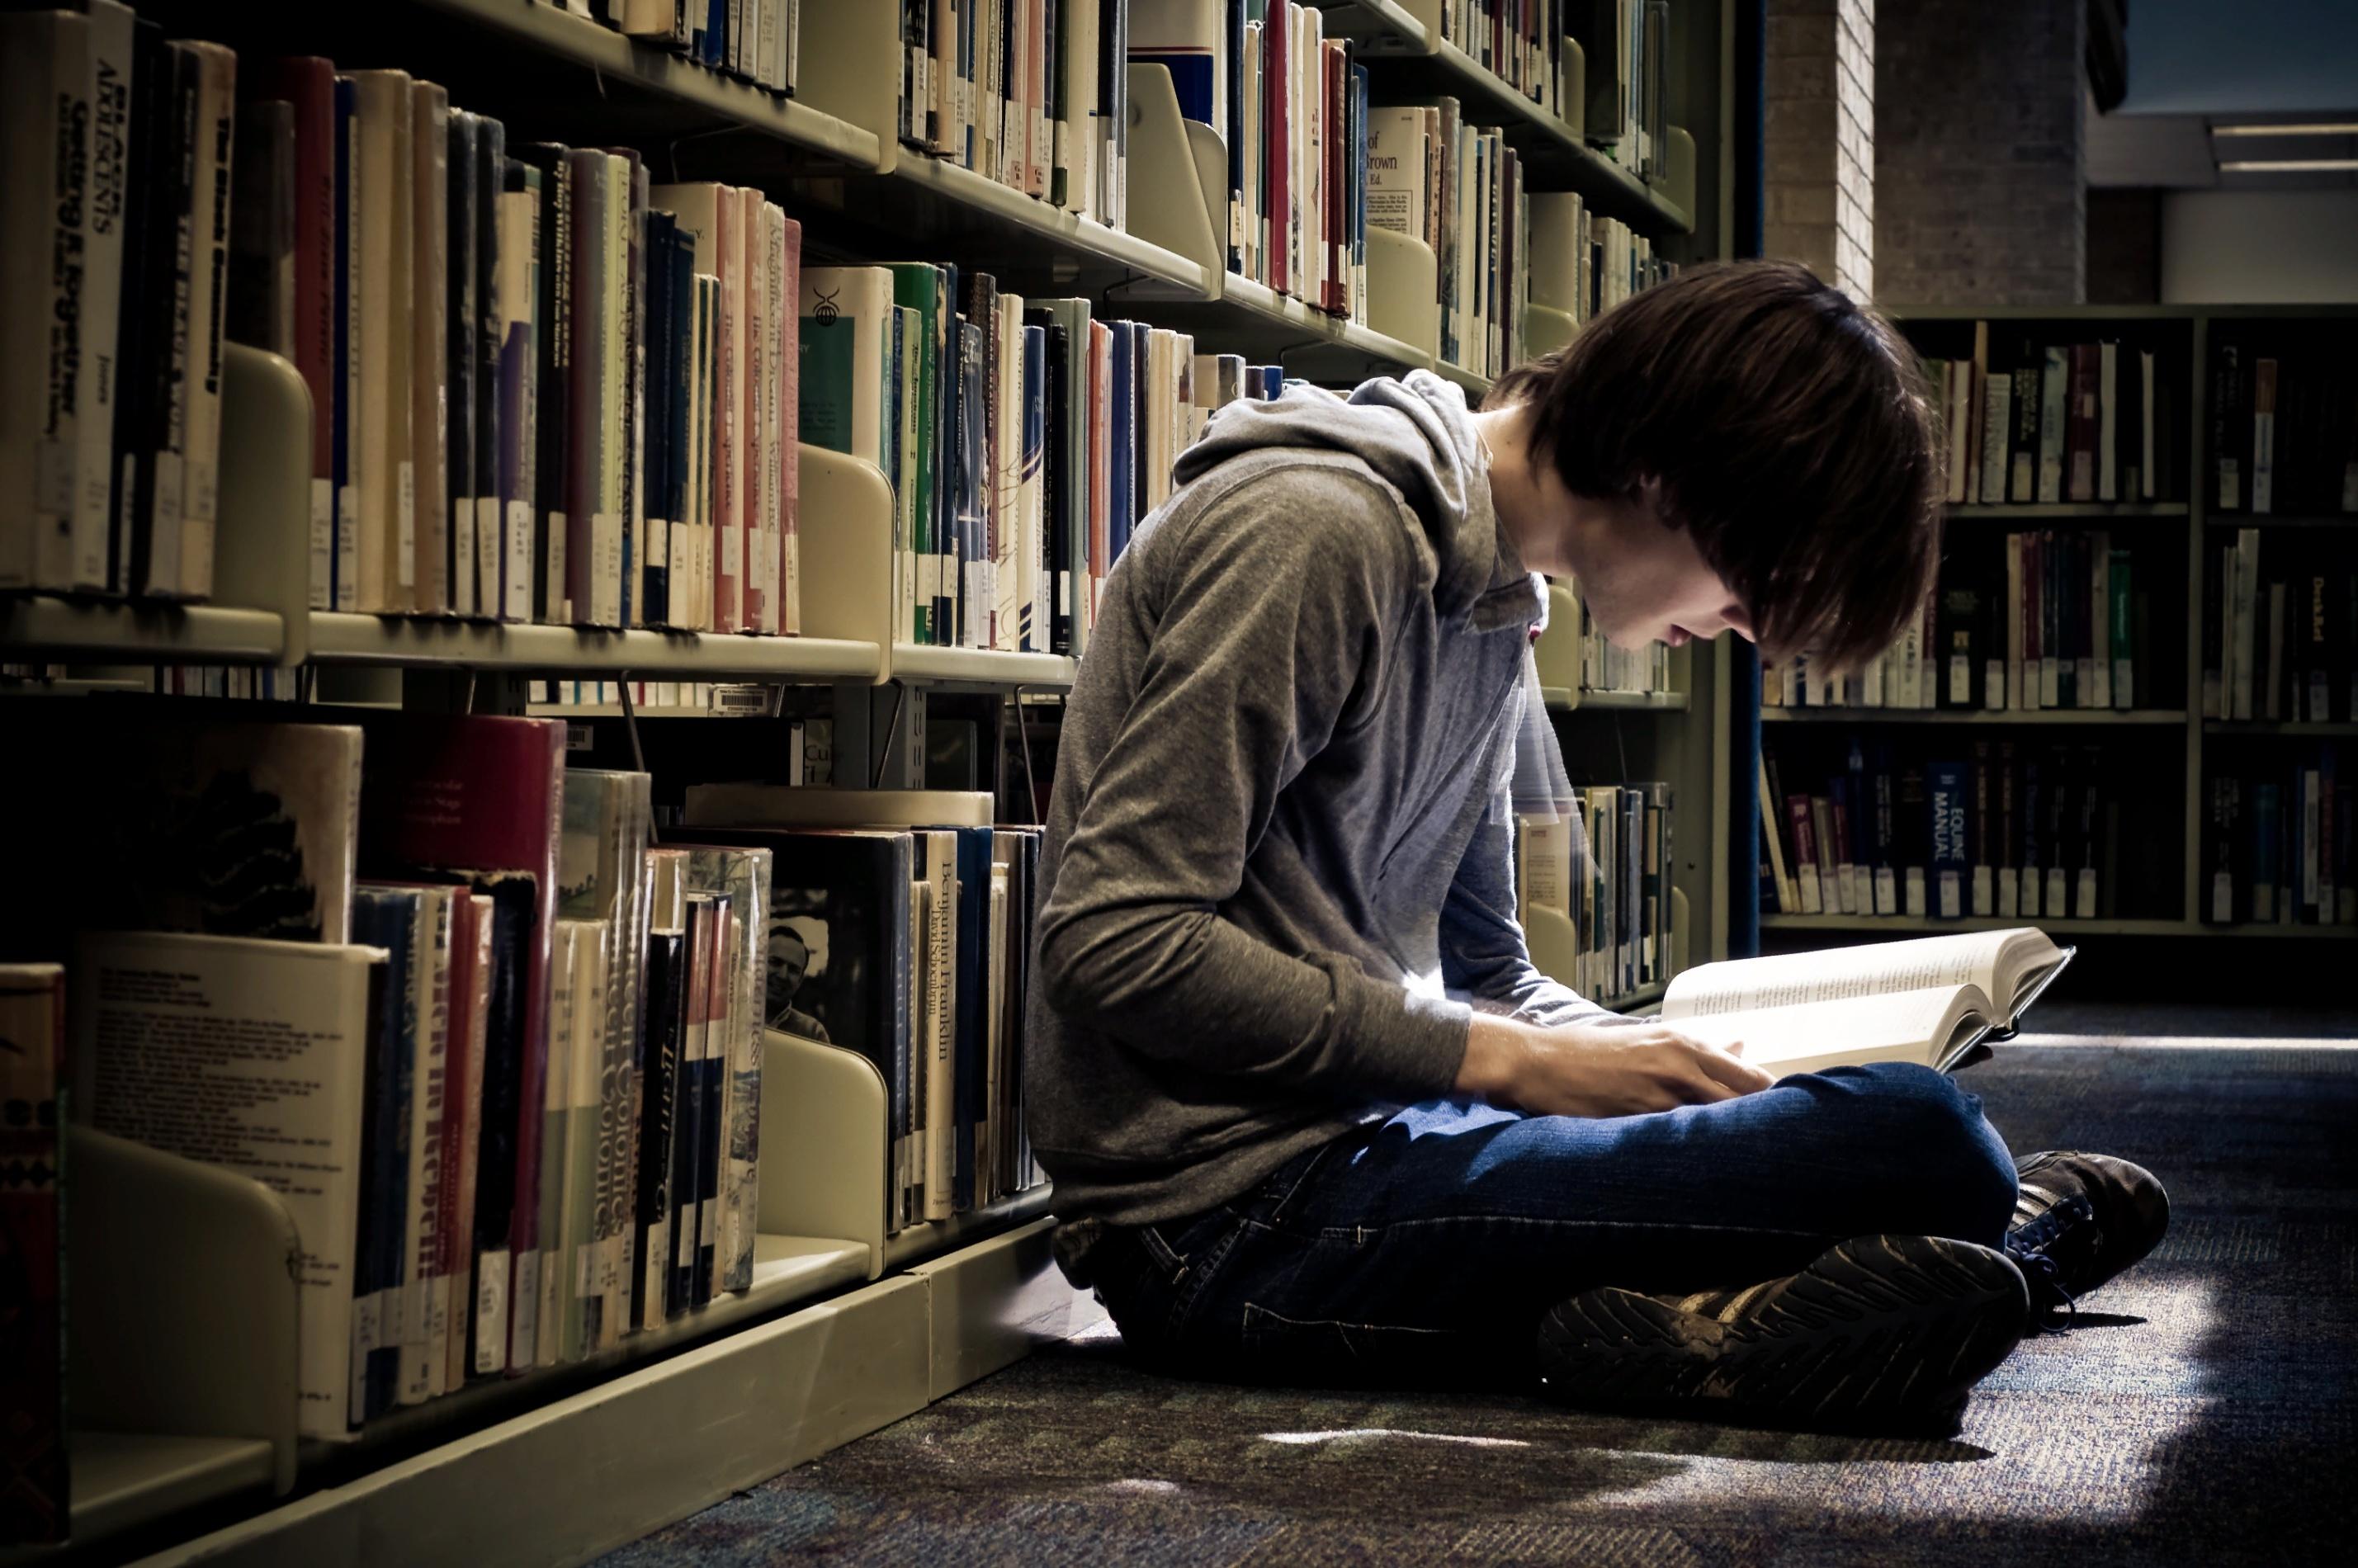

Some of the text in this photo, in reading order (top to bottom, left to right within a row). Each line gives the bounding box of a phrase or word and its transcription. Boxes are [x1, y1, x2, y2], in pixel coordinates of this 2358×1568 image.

[92, 59, 119, 236] ADOLESCENTS
[1368, 130, 1380, 150] of
[1370, 173, 1383, 186] Ed.
[555, 212, 565, 274] Wilkins
[767, 223, 781, 345] Magnificent
[1933, 791, 1950, 864] MANUAL
[1949, 806, 1966, 862] EQUINE
[929, 909, 943, 1015] David Schoenbrun
[938, 860, 952, 1063] Benjamin Franklin
[593, 1062, 618, 1242] Colonies
[609, 1058, 635, 1235] Colonies
